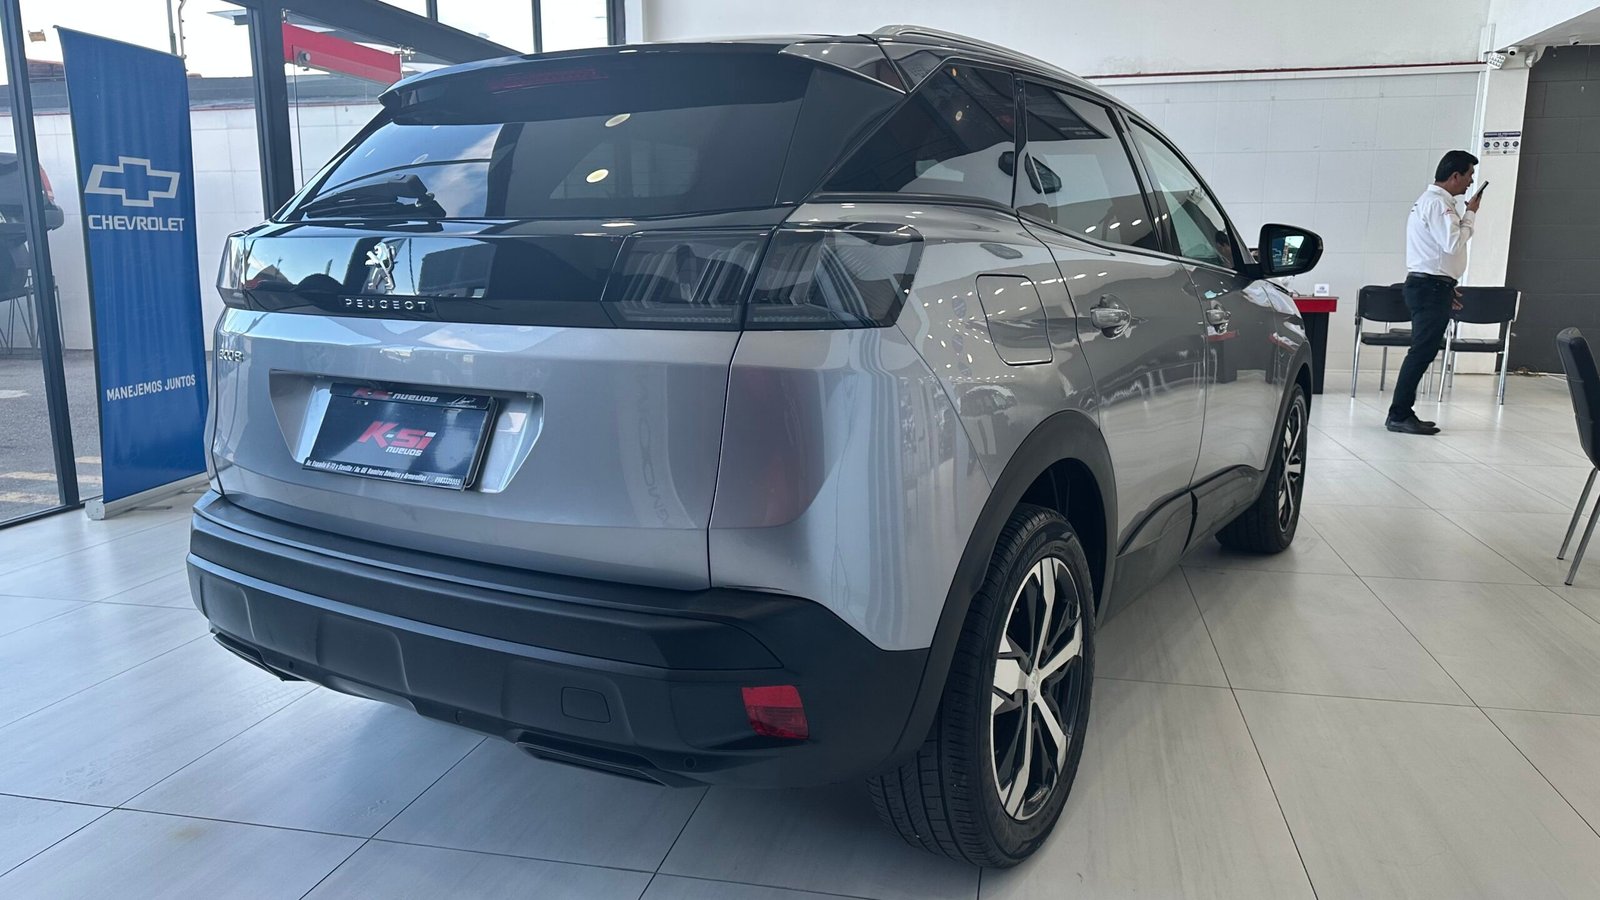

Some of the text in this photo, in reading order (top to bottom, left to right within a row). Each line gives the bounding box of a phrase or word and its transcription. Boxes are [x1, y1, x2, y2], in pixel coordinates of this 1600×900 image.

[88, 214, 185, 232] CHEVROLET
[345, 298, 426, 311] PEUGEOT
[106, 374, 196, 402] MANEJEMOS JUNTOS
[392, 393, 438, 403] nuevos
[385, 446, 423, 457] nuevos
